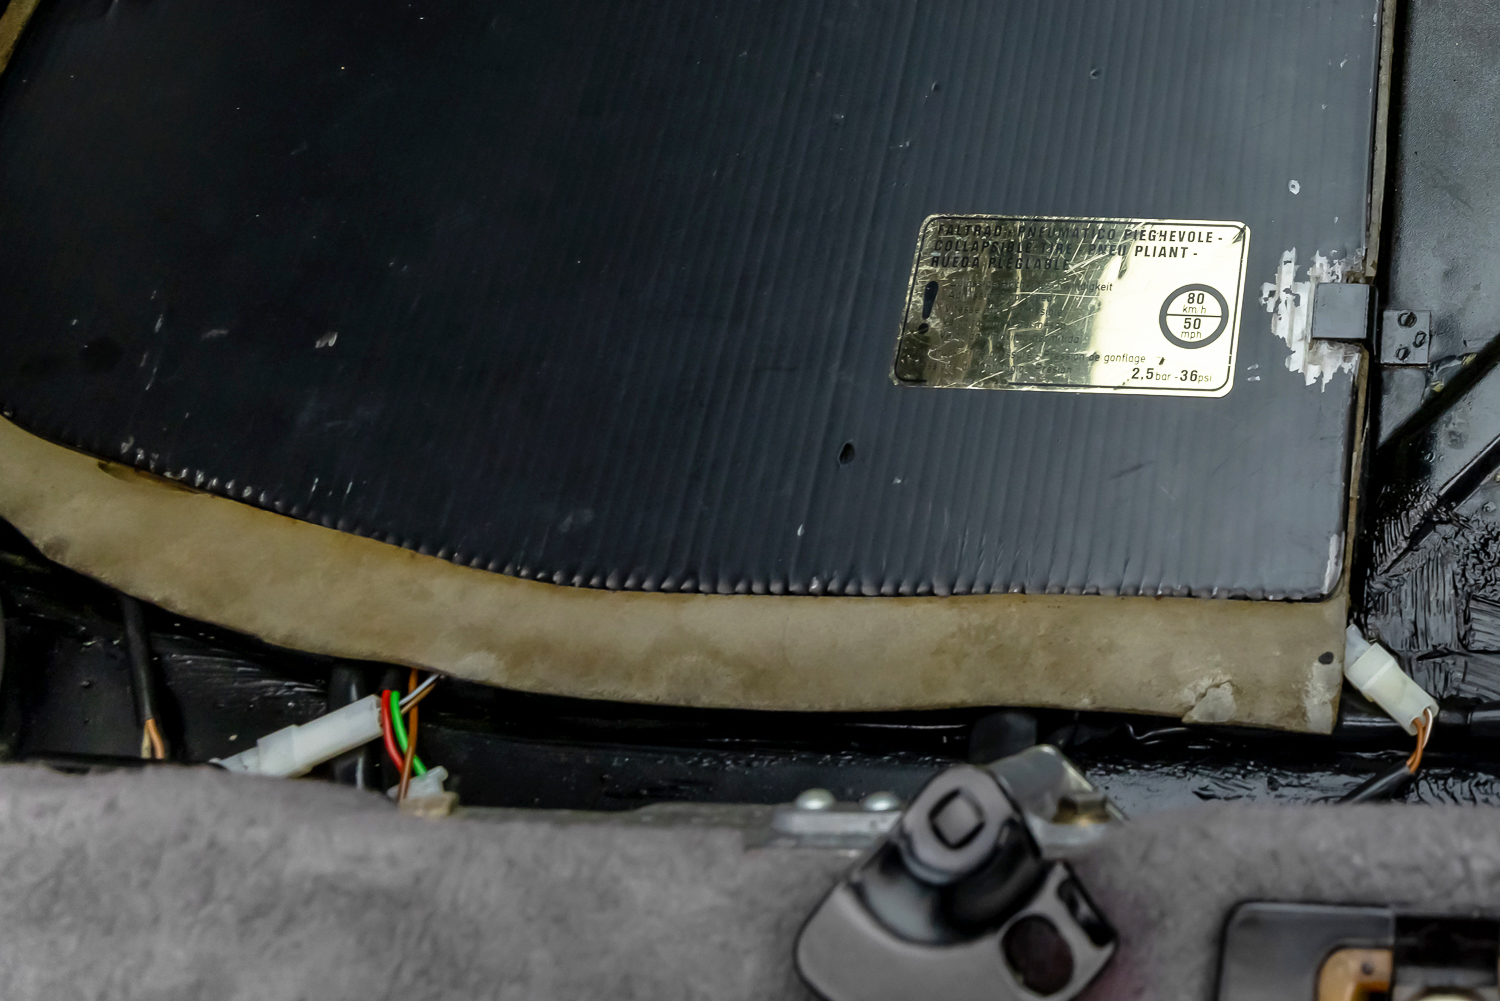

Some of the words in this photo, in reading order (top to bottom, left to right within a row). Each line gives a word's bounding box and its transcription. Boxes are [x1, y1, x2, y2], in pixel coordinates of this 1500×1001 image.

[937, 223, 1002, 238] FALTRAD
[1123, 229, 1214, 244] PIEGHEVOLE
[1134, 244, 1189, 259] PLIANT
[930, 255, 980, 269] RUEDA
[1186, 292, 1205, 305] 80
[1182, 304, 1207, 315] km/h
[1183, 317, 1202, 330] 50
[1180, 329, 1202, 341] mph
[1103, 353, 1146, 365] gonflage
[1155, 371, 1171, 382] bar
[1179, 369, 1198, 382] 36
